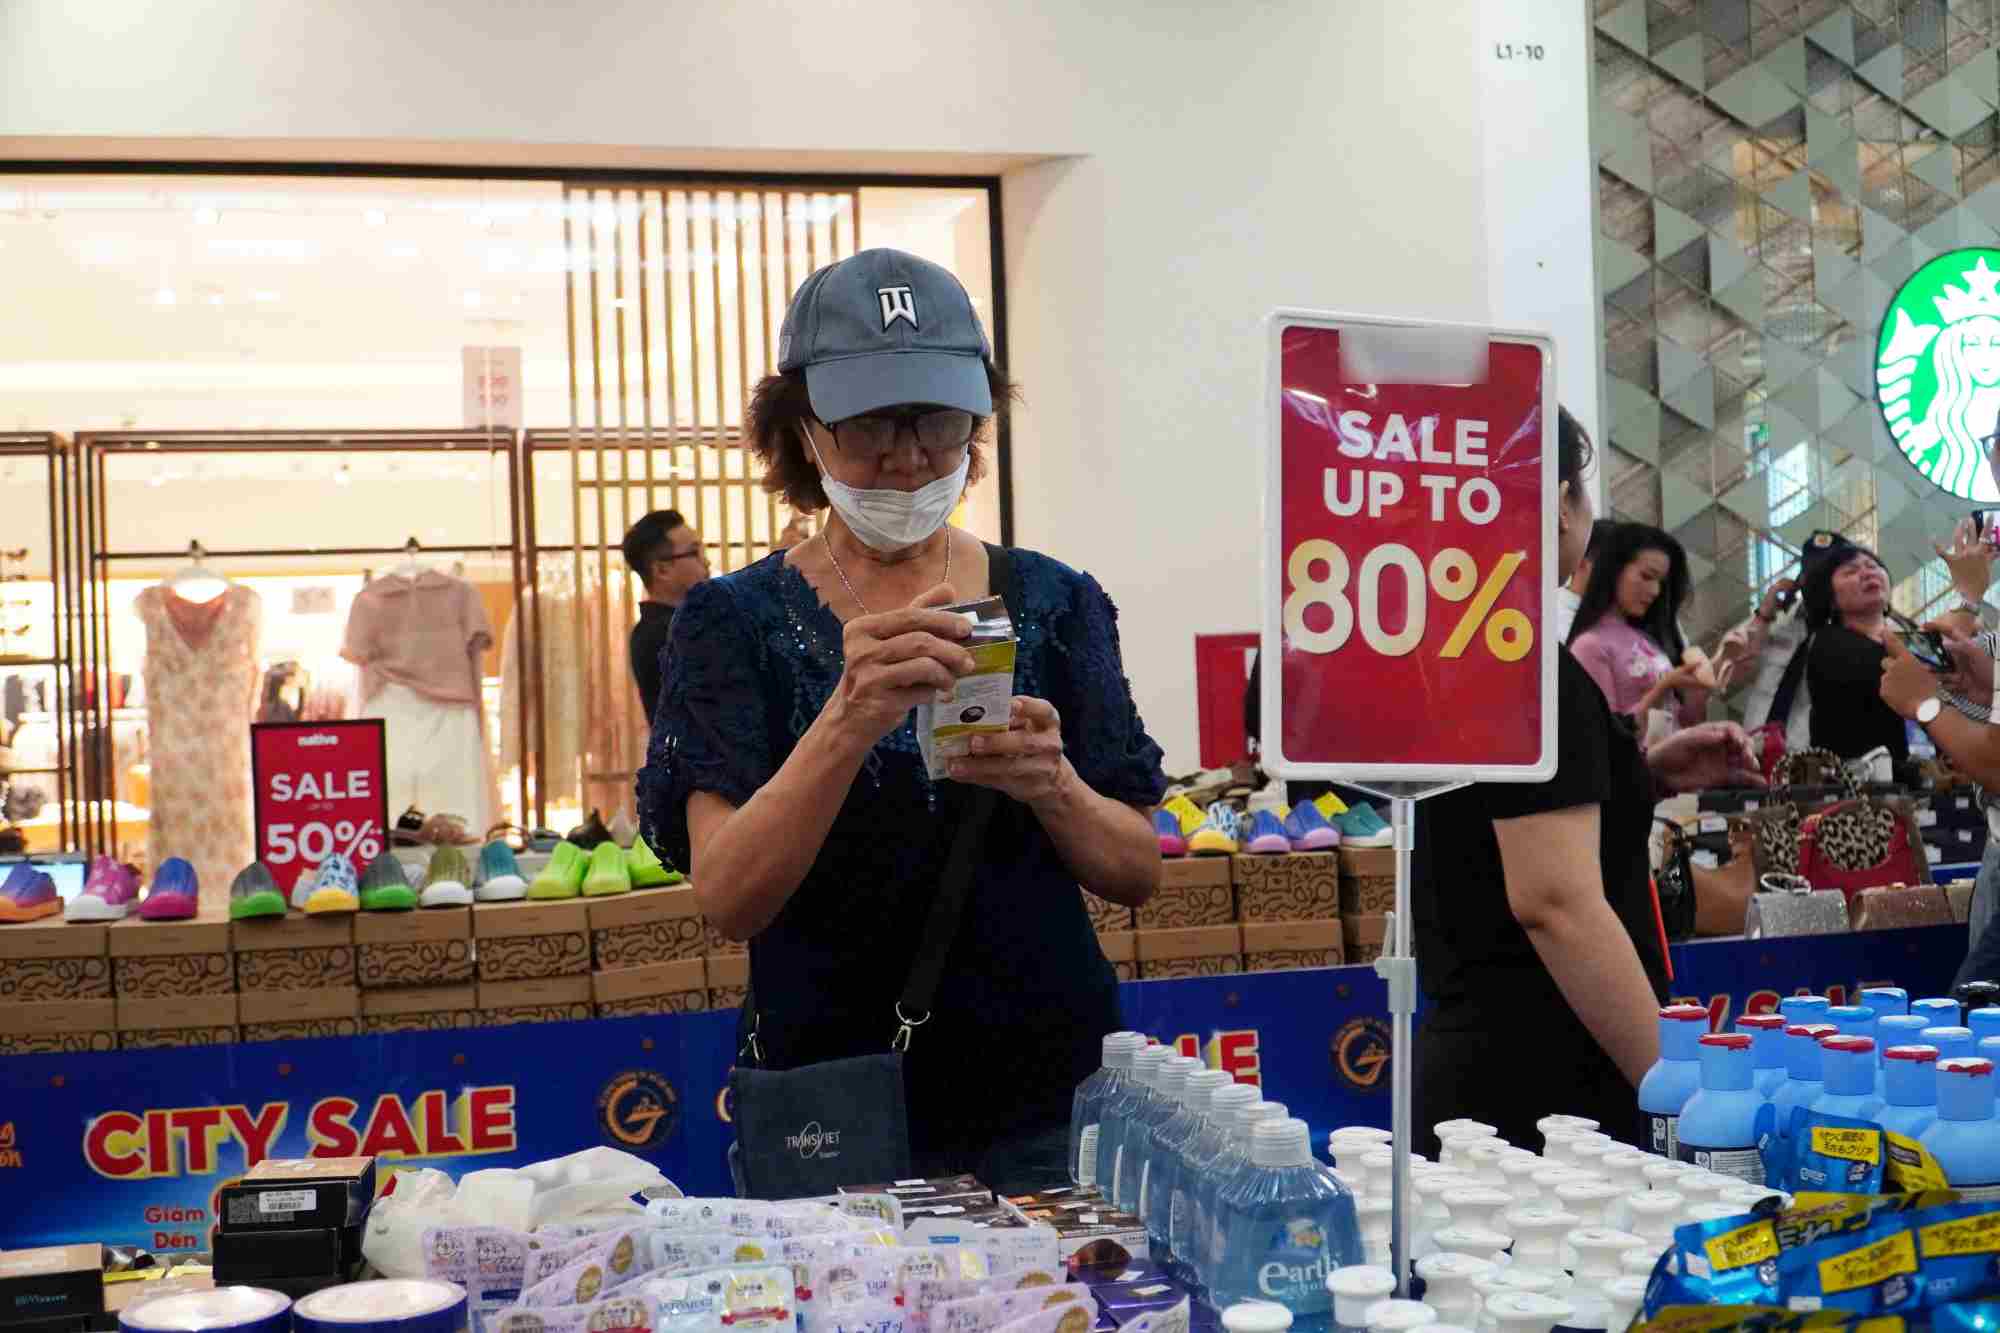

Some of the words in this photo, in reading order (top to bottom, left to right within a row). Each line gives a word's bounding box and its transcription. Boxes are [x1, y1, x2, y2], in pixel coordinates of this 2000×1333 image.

[1496, 44, 1544, 61] L1-10
[1336, 408, 1489, 466] SALE
[1323, 467, 1403, 518] UP
[1420, 475, 1502, 525] TO
[1283, 538, 1534, 662] 80%
[270, 770, 371, 802] SALE
[266, 820, 380, 864] 50%
[83, 1103, 288, 1179] CITY
[310, 1084, 517, 1159] SALE
[1258, 1249, 1341, 1296] earth
